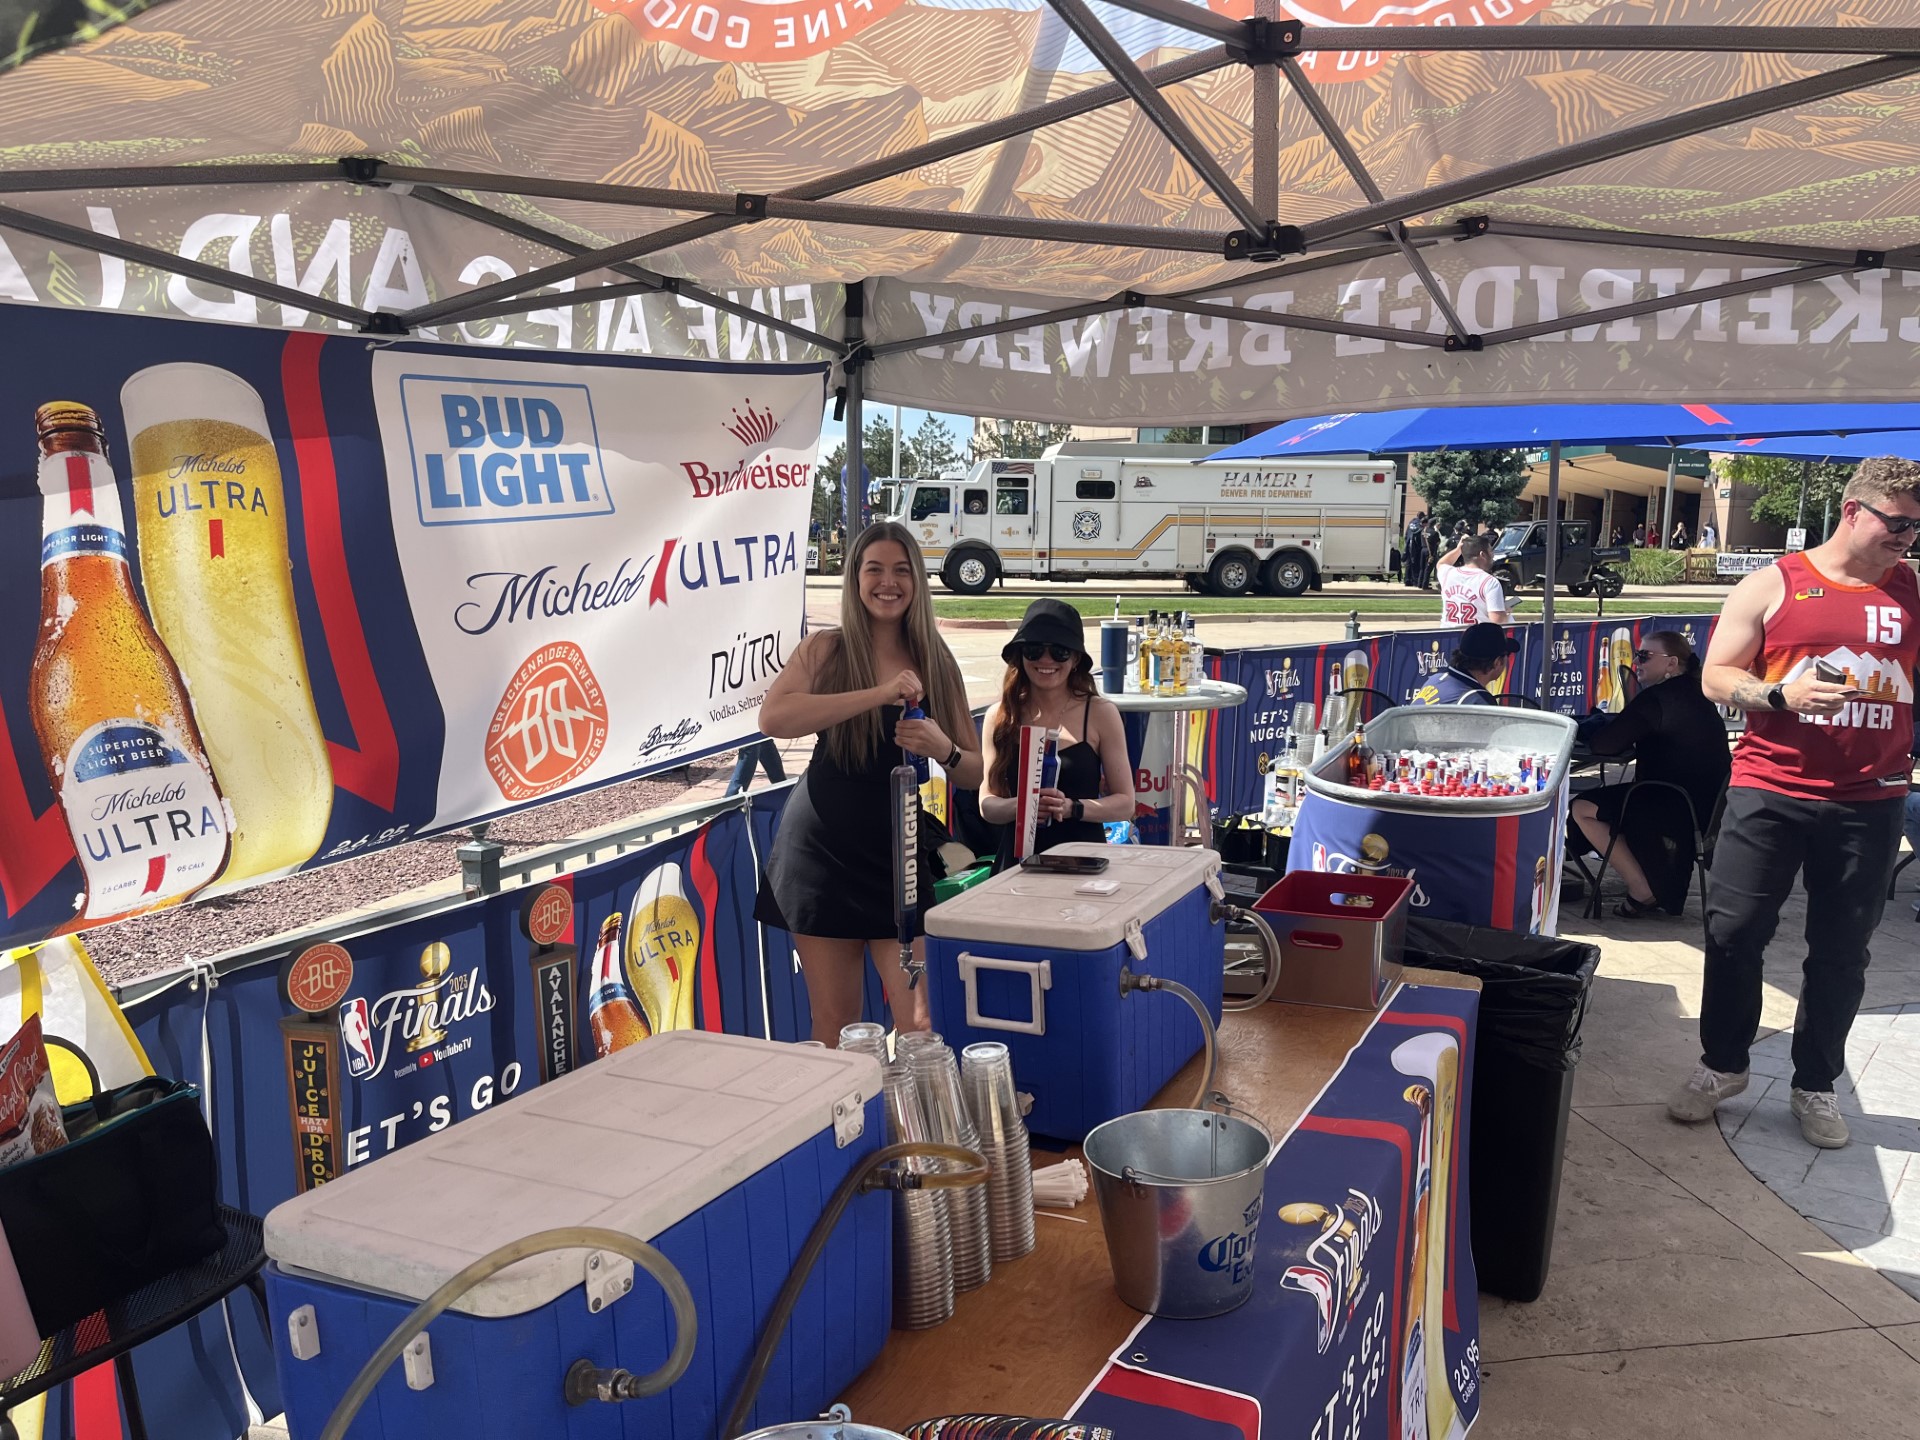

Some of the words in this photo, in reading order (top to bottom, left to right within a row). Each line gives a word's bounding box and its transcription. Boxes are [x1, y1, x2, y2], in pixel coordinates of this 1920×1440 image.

[441, 394, 564, 448] BUD
[168, 453, 246, 478] Michelob
[425, 453, 590, 509] LIGHT
[680, 454, 810, 498] Budweiser
[1221, 472, 1297, 488] HAMER
[1305, 473, 1313, 488] 1
[156, 480, 269, 517] ULTRA
[1220, 489, 1247, 498] DENVER
[1251, 490, 1267, 498] FIRE
[1268, 490, 1312, 498] DEPARTMENT
[43, 535, 77, 554] UPERIOR
[81, 534, 108, 542] LIGHT
[454, 555, 655, 636] Michelob
[680, 530, 798, 591] ULTRA
[1444, 584, 1478, 603] BUTLER
[1446, 600, 1478, 624] 22
[1864, 605, 1902, 644] 15
[491, 646, 569, 733] BRECKENRIDGE
[568, 648, 604, 708] BREWERY
[1269, 668, 1301, 698] Finals
[1535, 684, 1585, 698] NGGETS!
[1538, 671, 1568, 684] LT'S
[1570, 671, 1582, 683] GO
[1254, 708, 1289, 725] LET'S
[1798, 701, 1894, 730] NVER
[88, 737, 154, 756] SUPERIOR
[638, 717, 702, 753] Brooklyn's
[1250, 726, 1284, 743] NUGG
[87, 754, 125, 770] LIGHT
[131, 749, 164, 761] BEER
[489, 753, 514, 789] FINE
[509, 785, 534, 799] ALES
[533, 780, 561, 796] AND
[566, 727, 605, 781] LAGERS
[90, 781, 186, 821] Michelob
[928, 803, 944, 816] TRA
[83, 805, 220, 862] ULTRA
[905, 792, 918, 857] LIGHT
[177, 865, 187, 873] 95
[188, 861, 205, 872] CALS
[905, 858, 918, 905] BUD
[113, 879, 137, 892] CARBS
[633, 929, 694, 967] ULTRA
[364, 967, 497, 1081] Finals
[449, 973, 469, 993] 2023
[548, 966, 566, 1074] AVALANCHE
[303, 1045, 319, 1117] JUICE
[352, 1056, 366, 1071] NBA
[300, 1118, 328, 1126] HAZY
[307, 1126, 323, 1134] IPA
[347, 1095, 451, 1167] ET'S
[470, 1061, 522, 1111] GO
[1306, 1188, 1382, 1355] Finals
[1311, 1355, 1355, 1440] ET'S
[1361, 1291, 1385, 1365] GO
[1453, 1361, 1470, 1392] 2.6
[1465, 1338, 1480, 1366] 95
[1344, 1335, 1386, 1440] ETS!
[1462, 1381, 1477, 1404] CARBS
